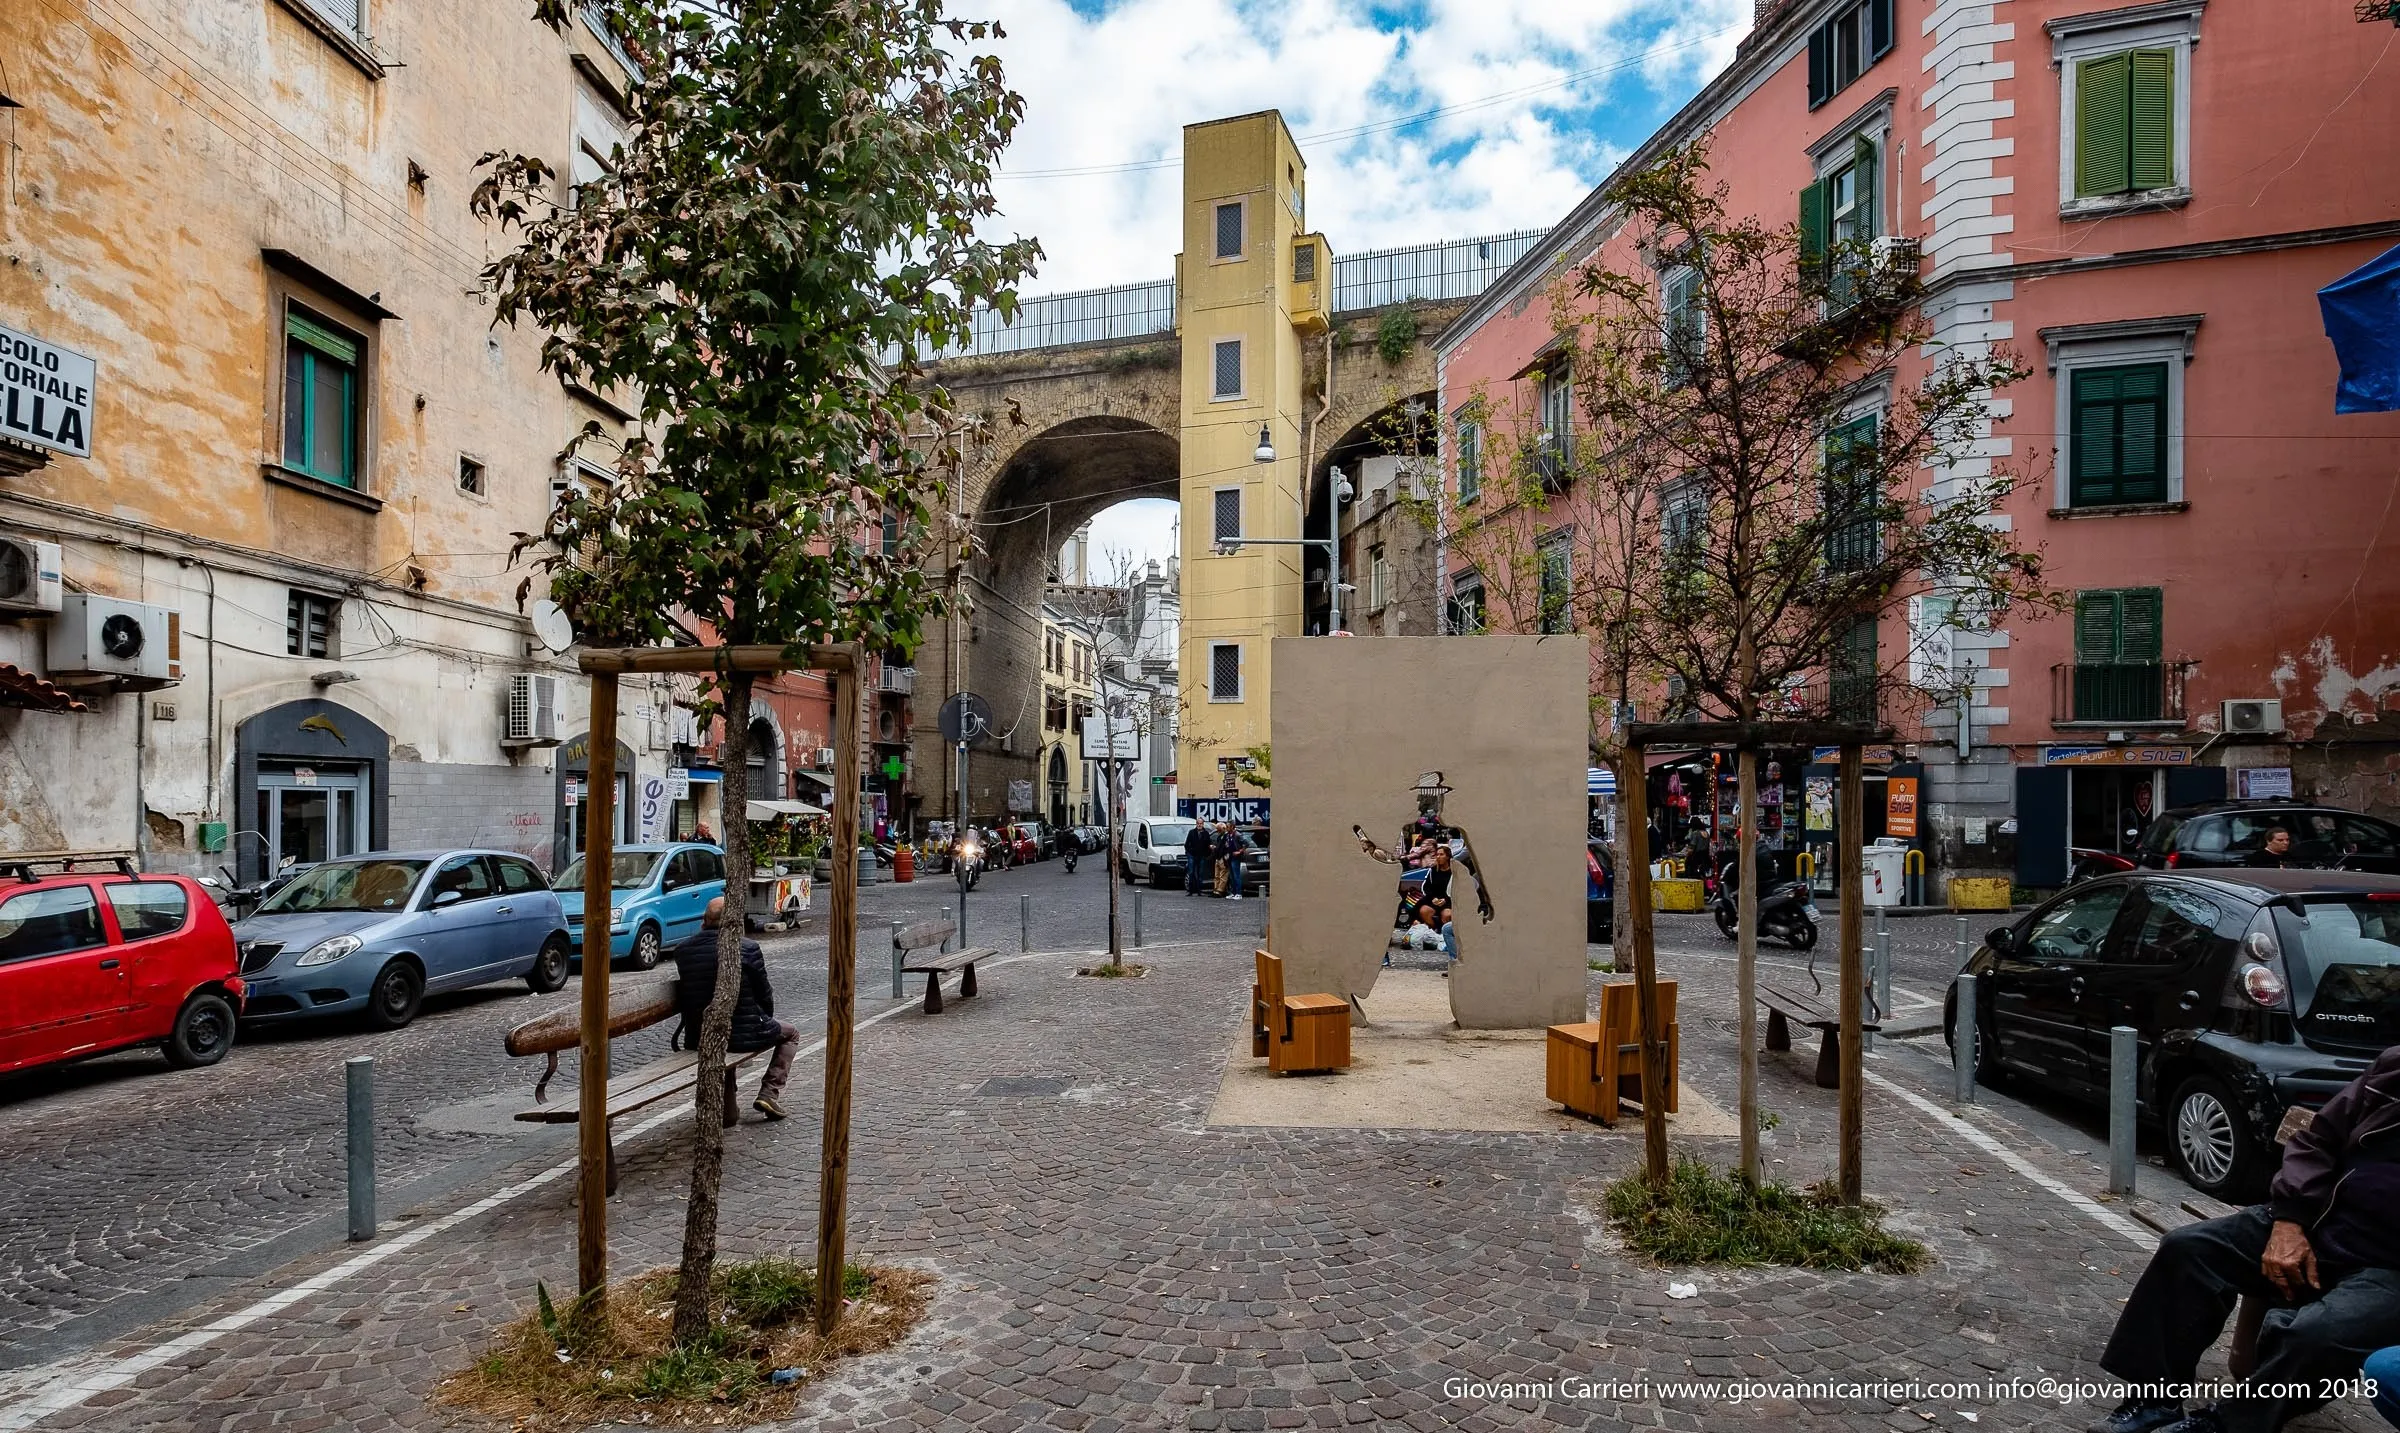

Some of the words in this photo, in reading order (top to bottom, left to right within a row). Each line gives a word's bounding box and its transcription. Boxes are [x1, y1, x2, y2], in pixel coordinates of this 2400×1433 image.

[0, 358, 88, 407] ORIALE
[0, 383, 85, 450] LLA
[160, 705, 175, 717] 116
[2048, 750, 2088, 763] Cartoleria
[2080, 750, 2116, 763] PUNTO
[1891, 794, 1915, 803] PUNTO
[1196, 802, 1259, 822] RIONE
